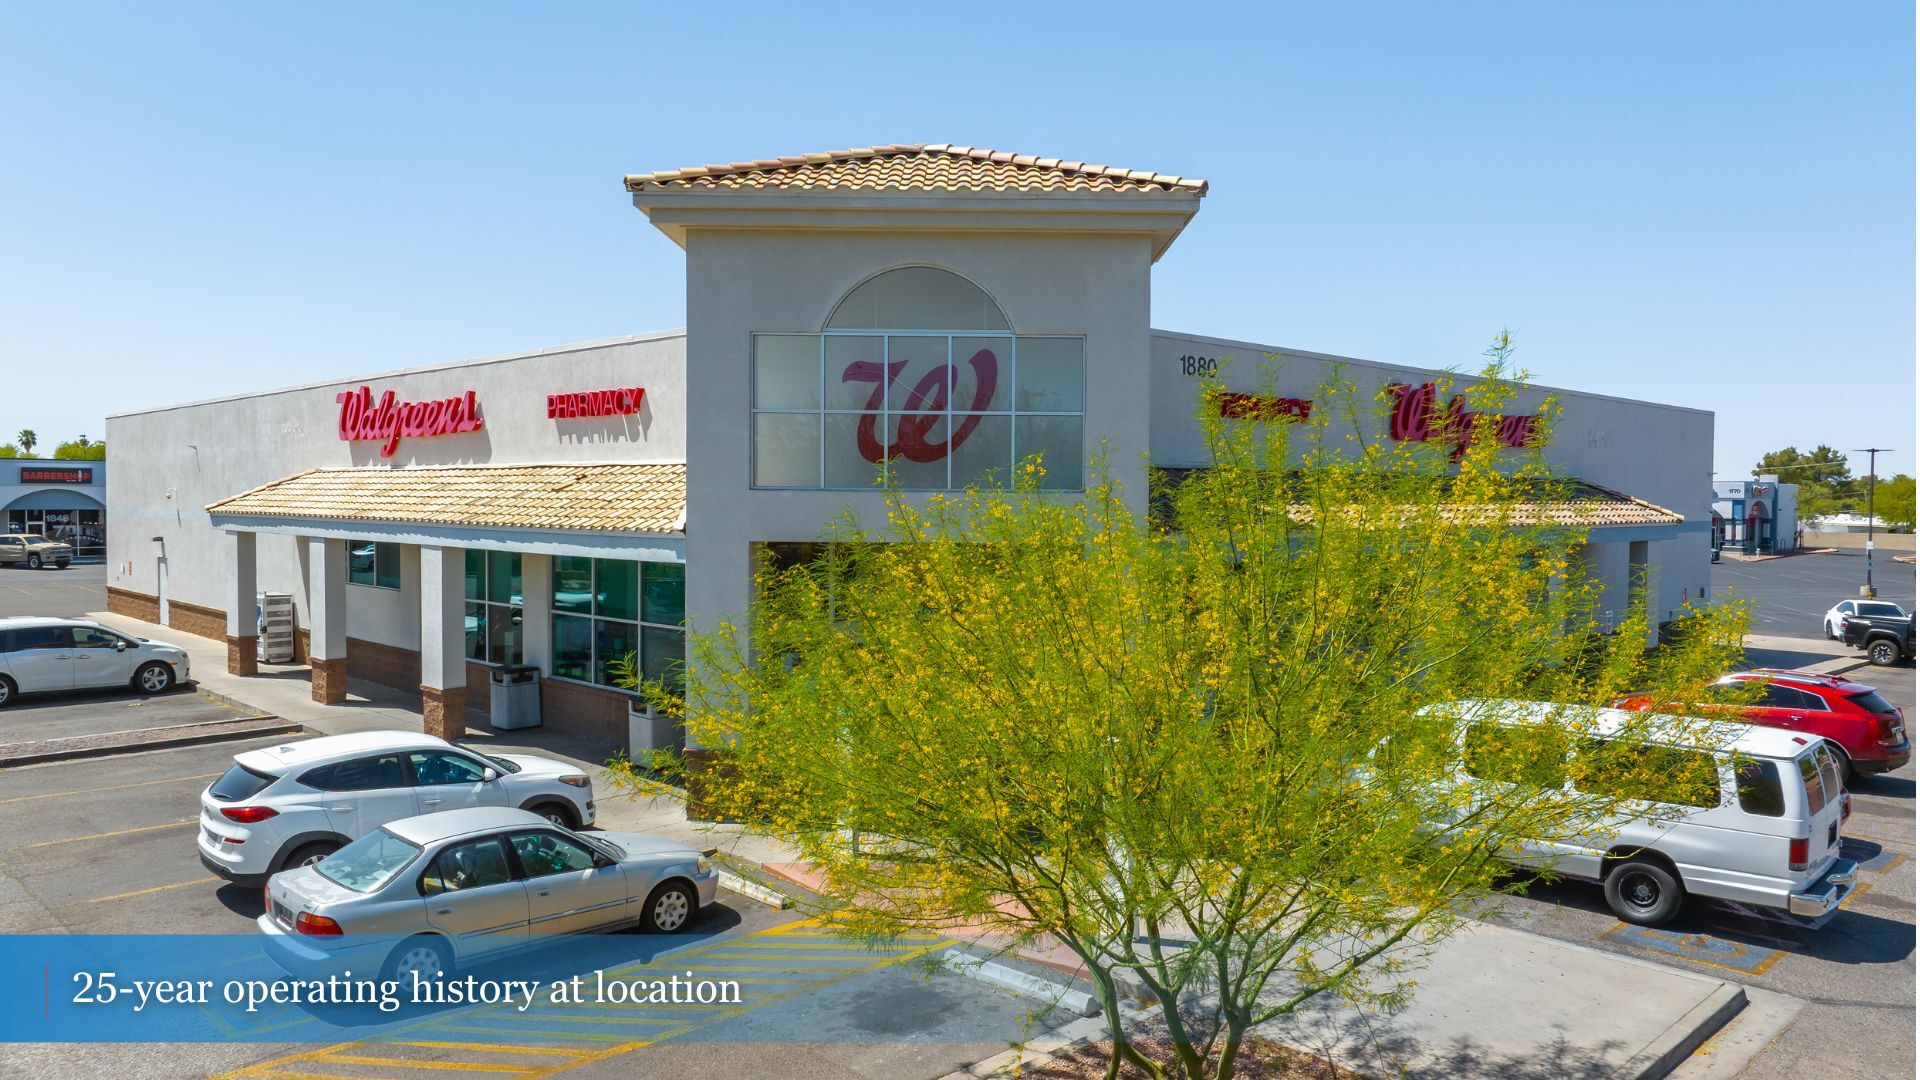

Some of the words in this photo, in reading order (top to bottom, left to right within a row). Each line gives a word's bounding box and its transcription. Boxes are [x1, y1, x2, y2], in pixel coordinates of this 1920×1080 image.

[1180, 354, 1217, 378] 1880
[547, 387, 645, 419] PHARMACY
[335, 385, 483, 458] Walgreens
[22, 471, 90, 480] BARBERSHOP
[46, 514, 69, 522] 1848
